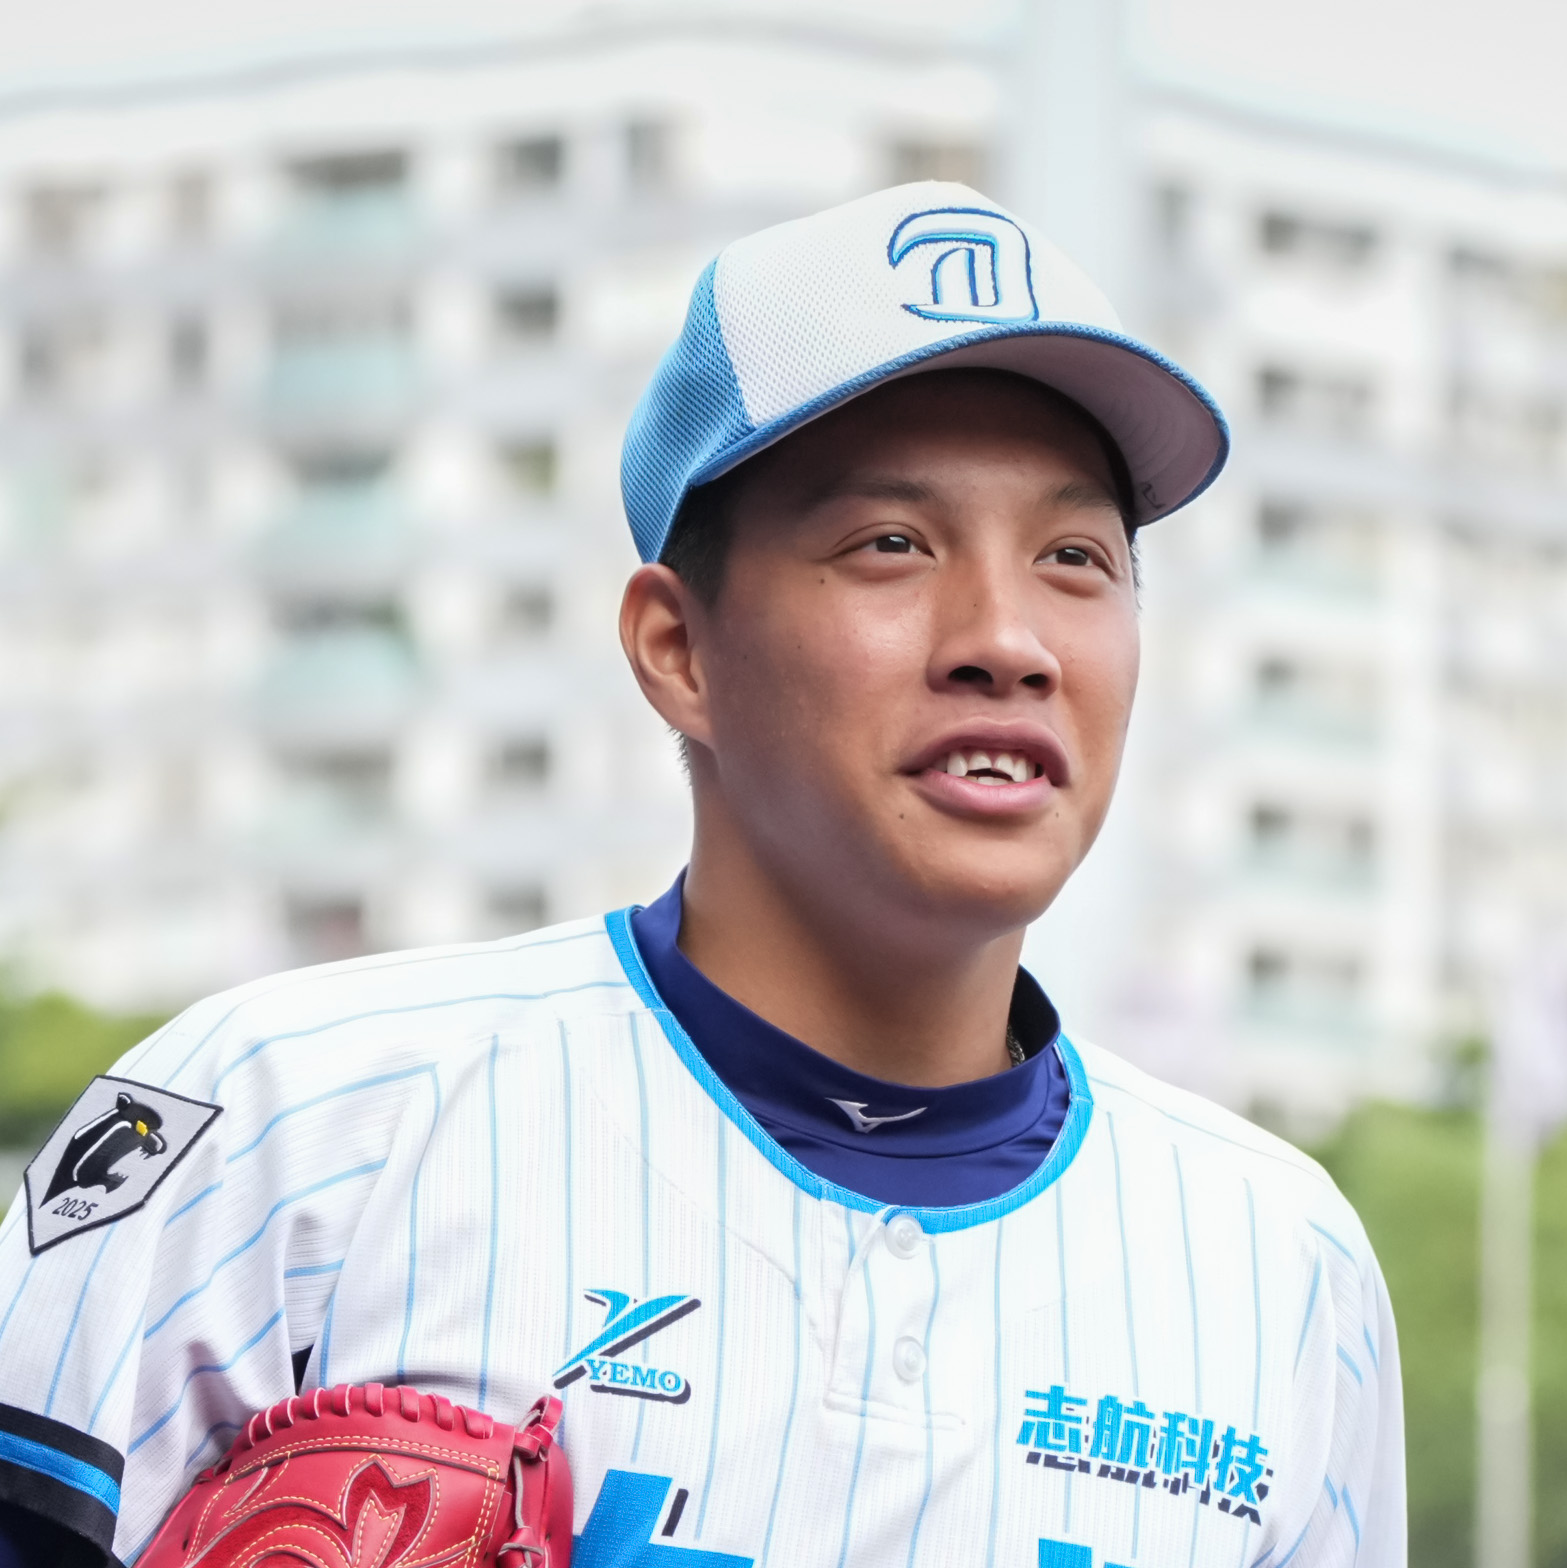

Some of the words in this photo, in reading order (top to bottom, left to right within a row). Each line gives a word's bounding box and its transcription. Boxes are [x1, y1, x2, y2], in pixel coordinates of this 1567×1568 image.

[52, 1197, 99, 1221] 2025
[585, 1356, 684, 1394] YEMO
[1016, 1384, 1272, 1510] 志航科技
